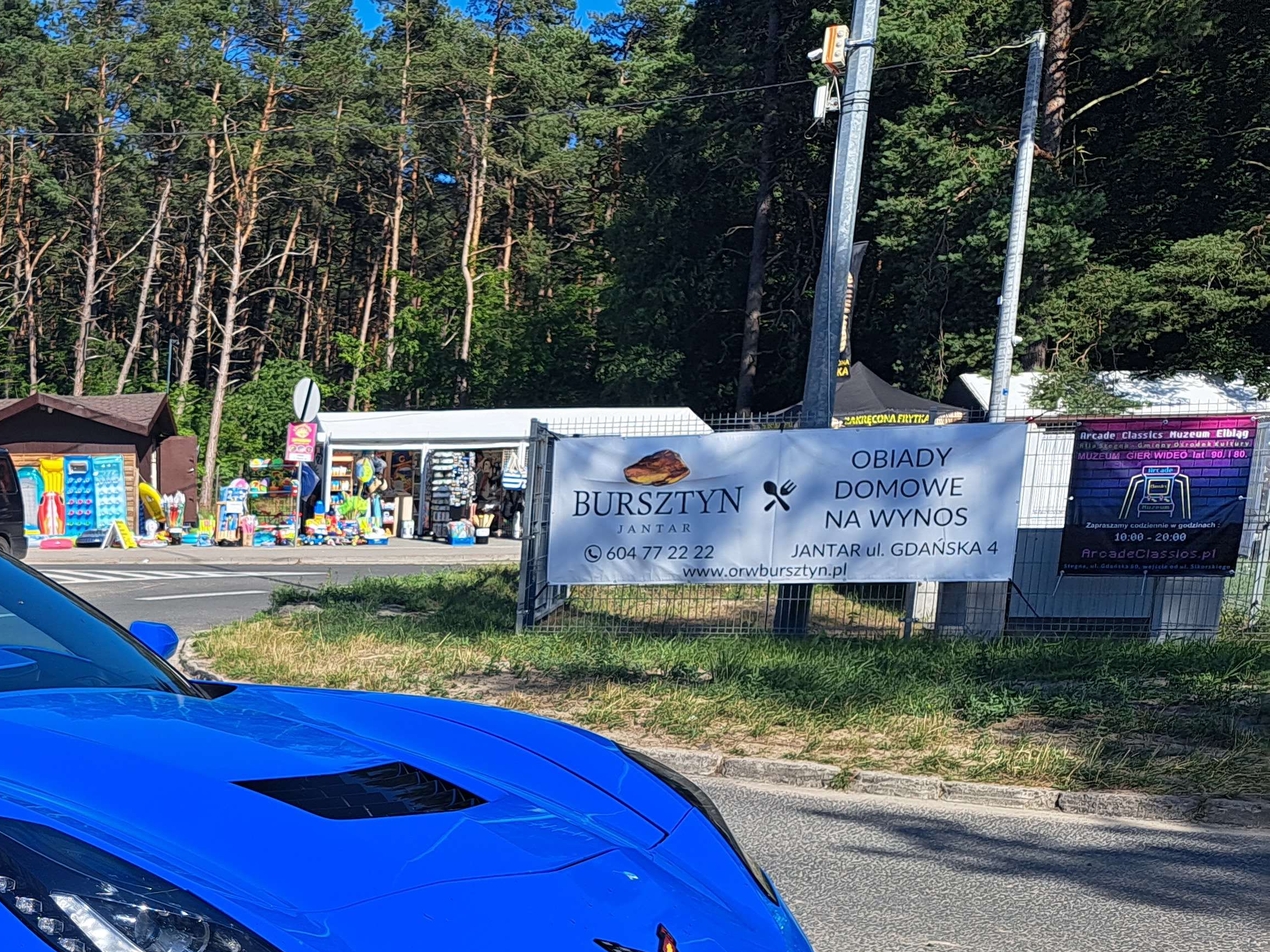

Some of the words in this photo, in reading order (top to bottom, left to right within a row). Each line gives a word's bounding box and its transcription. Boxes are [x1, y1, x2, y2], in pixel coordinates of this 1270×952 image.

[898, 414, 930, 424] FRYTKA
[1080, 431, 1116, 440] Arcade
[1122, 430, 1163, 440] Classics
[1170, 430, 1210, 438] Muzeum
[1216, 428, 1249, 439] Elbląg
[852, 446, 953, 469] OBIADY
[834, 477, 964, 500] DOMOWE
[572, 486, 745, 518] BURSZTYN
[825, 510, 861, 529] NA
[870, 507, 968, 528] WYNOS
[617, 523, 692, 534] JANTAR
[1114, 532, 1144, 541] 10:00
[1155, 532, 1187, 541] 20:00
[606, 546, 637, 560] 604
[642, 546, 663, 560] 77
[668, 545, 688, 560] 22
[694, 544, 714, 559] 22
[791, 544, 862, 558] JANTAR
[866, 542, 885, 557] ul.
[891, 538, 982, 556] GDAŃSKA
[988, 541, 998, 555] 4
[683, 562, 848, 580] www.orwbursztyn.pl
